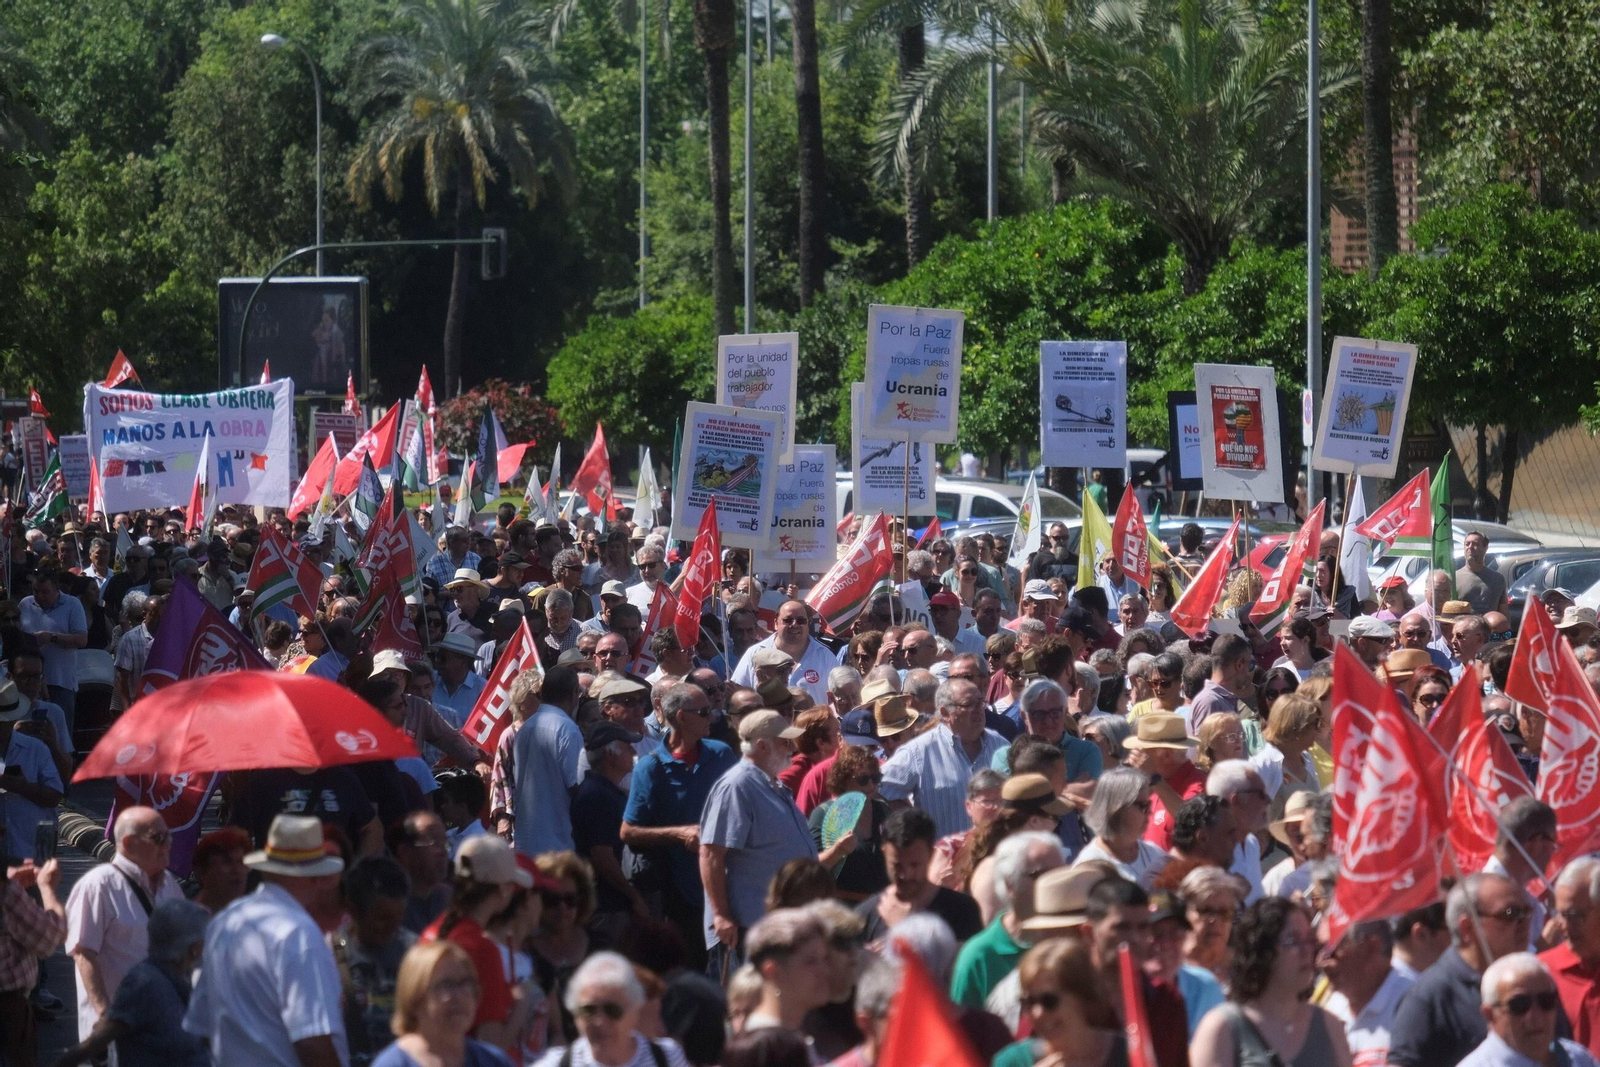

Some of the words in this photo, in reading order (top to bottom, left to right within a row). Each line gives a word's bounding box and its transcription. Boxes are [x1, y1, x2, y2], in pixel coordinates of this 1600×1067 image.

[880, 322, 905, 336] Por
[910, 324, 920, 337] la
[926, 325, 951, 339] Paz
[924, 344, 950, 354] Fuera
[728, 353, 744, 363] Por
[747, 353, 754, 363] la
[757, 352, 788, 362] unidad
[891, 355, 920, 366] tropas
[728, 368, 741, 378] del
[744, 367, 775, 379] pueblo
[727, 382, 773, 394] trabajador
[886, 380, 947, 397] Ucrania
[100, 393, 154, 417] SOMOS
[161, 393, 212, 409] CLASE
[217, 389, 275, 411] OBRERA
[102, 423, 166, 446] MANOS
[172, 421, 186, 439] A
[189, 420, 216, 438] LA
[220, 419, 267, 437] OBRA
[706, 424, 728, 432] ATRACO
[730, 428, 771, 437] MONOPOLISTA
[1220, 443, 1233, 452] QUE
[1244, 445, 1258, 454] NOS
[1227, 453, 1253, 462] DIVIDAN
[800, 461, 824, 473] Paz
